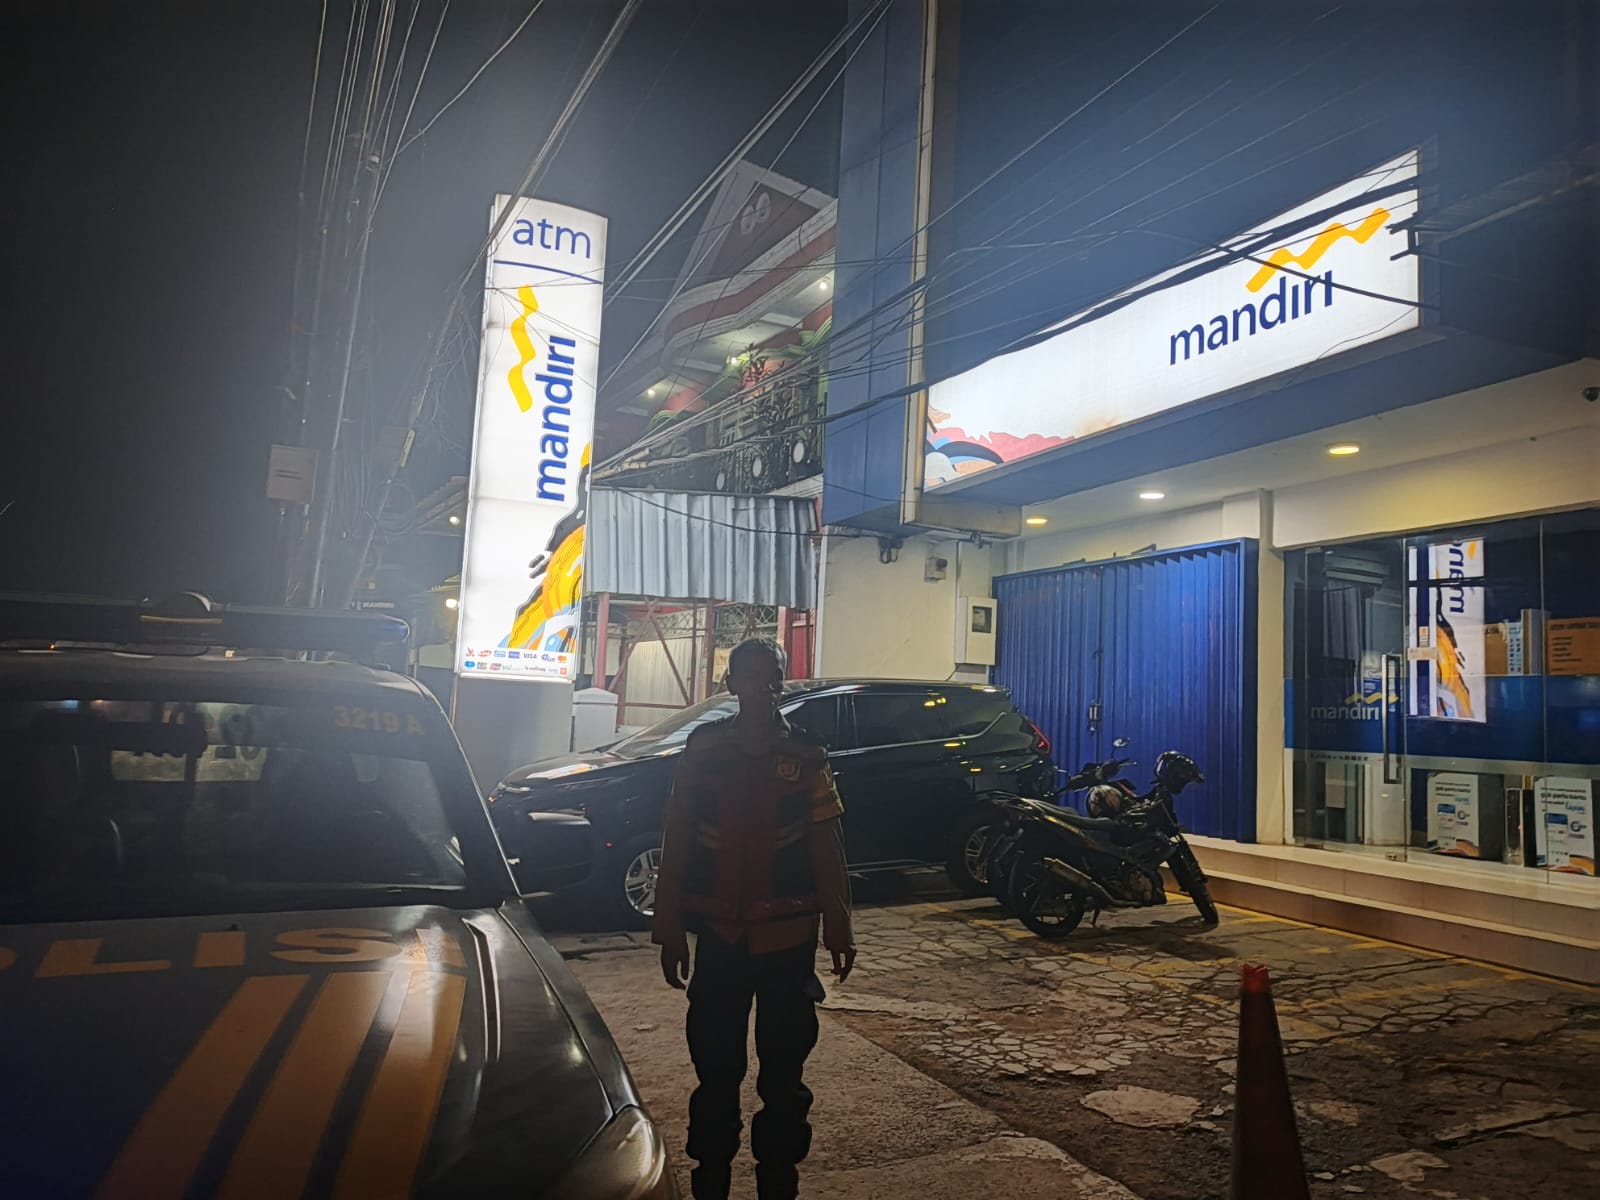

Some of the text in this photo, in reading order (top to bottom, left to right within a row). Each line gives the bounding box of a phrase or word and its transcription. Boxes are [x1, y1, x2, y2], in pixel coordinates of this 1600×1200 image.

[513, 216, 591, 259] atm
[1170, 271, 1333, 365] mandiri
[535, 335, 577, 502] mandiri
[334, 704, 401, 734] 3219
[1311, 703, 1380, 721] mandiri
[0, 926, 468, 979] LISI
